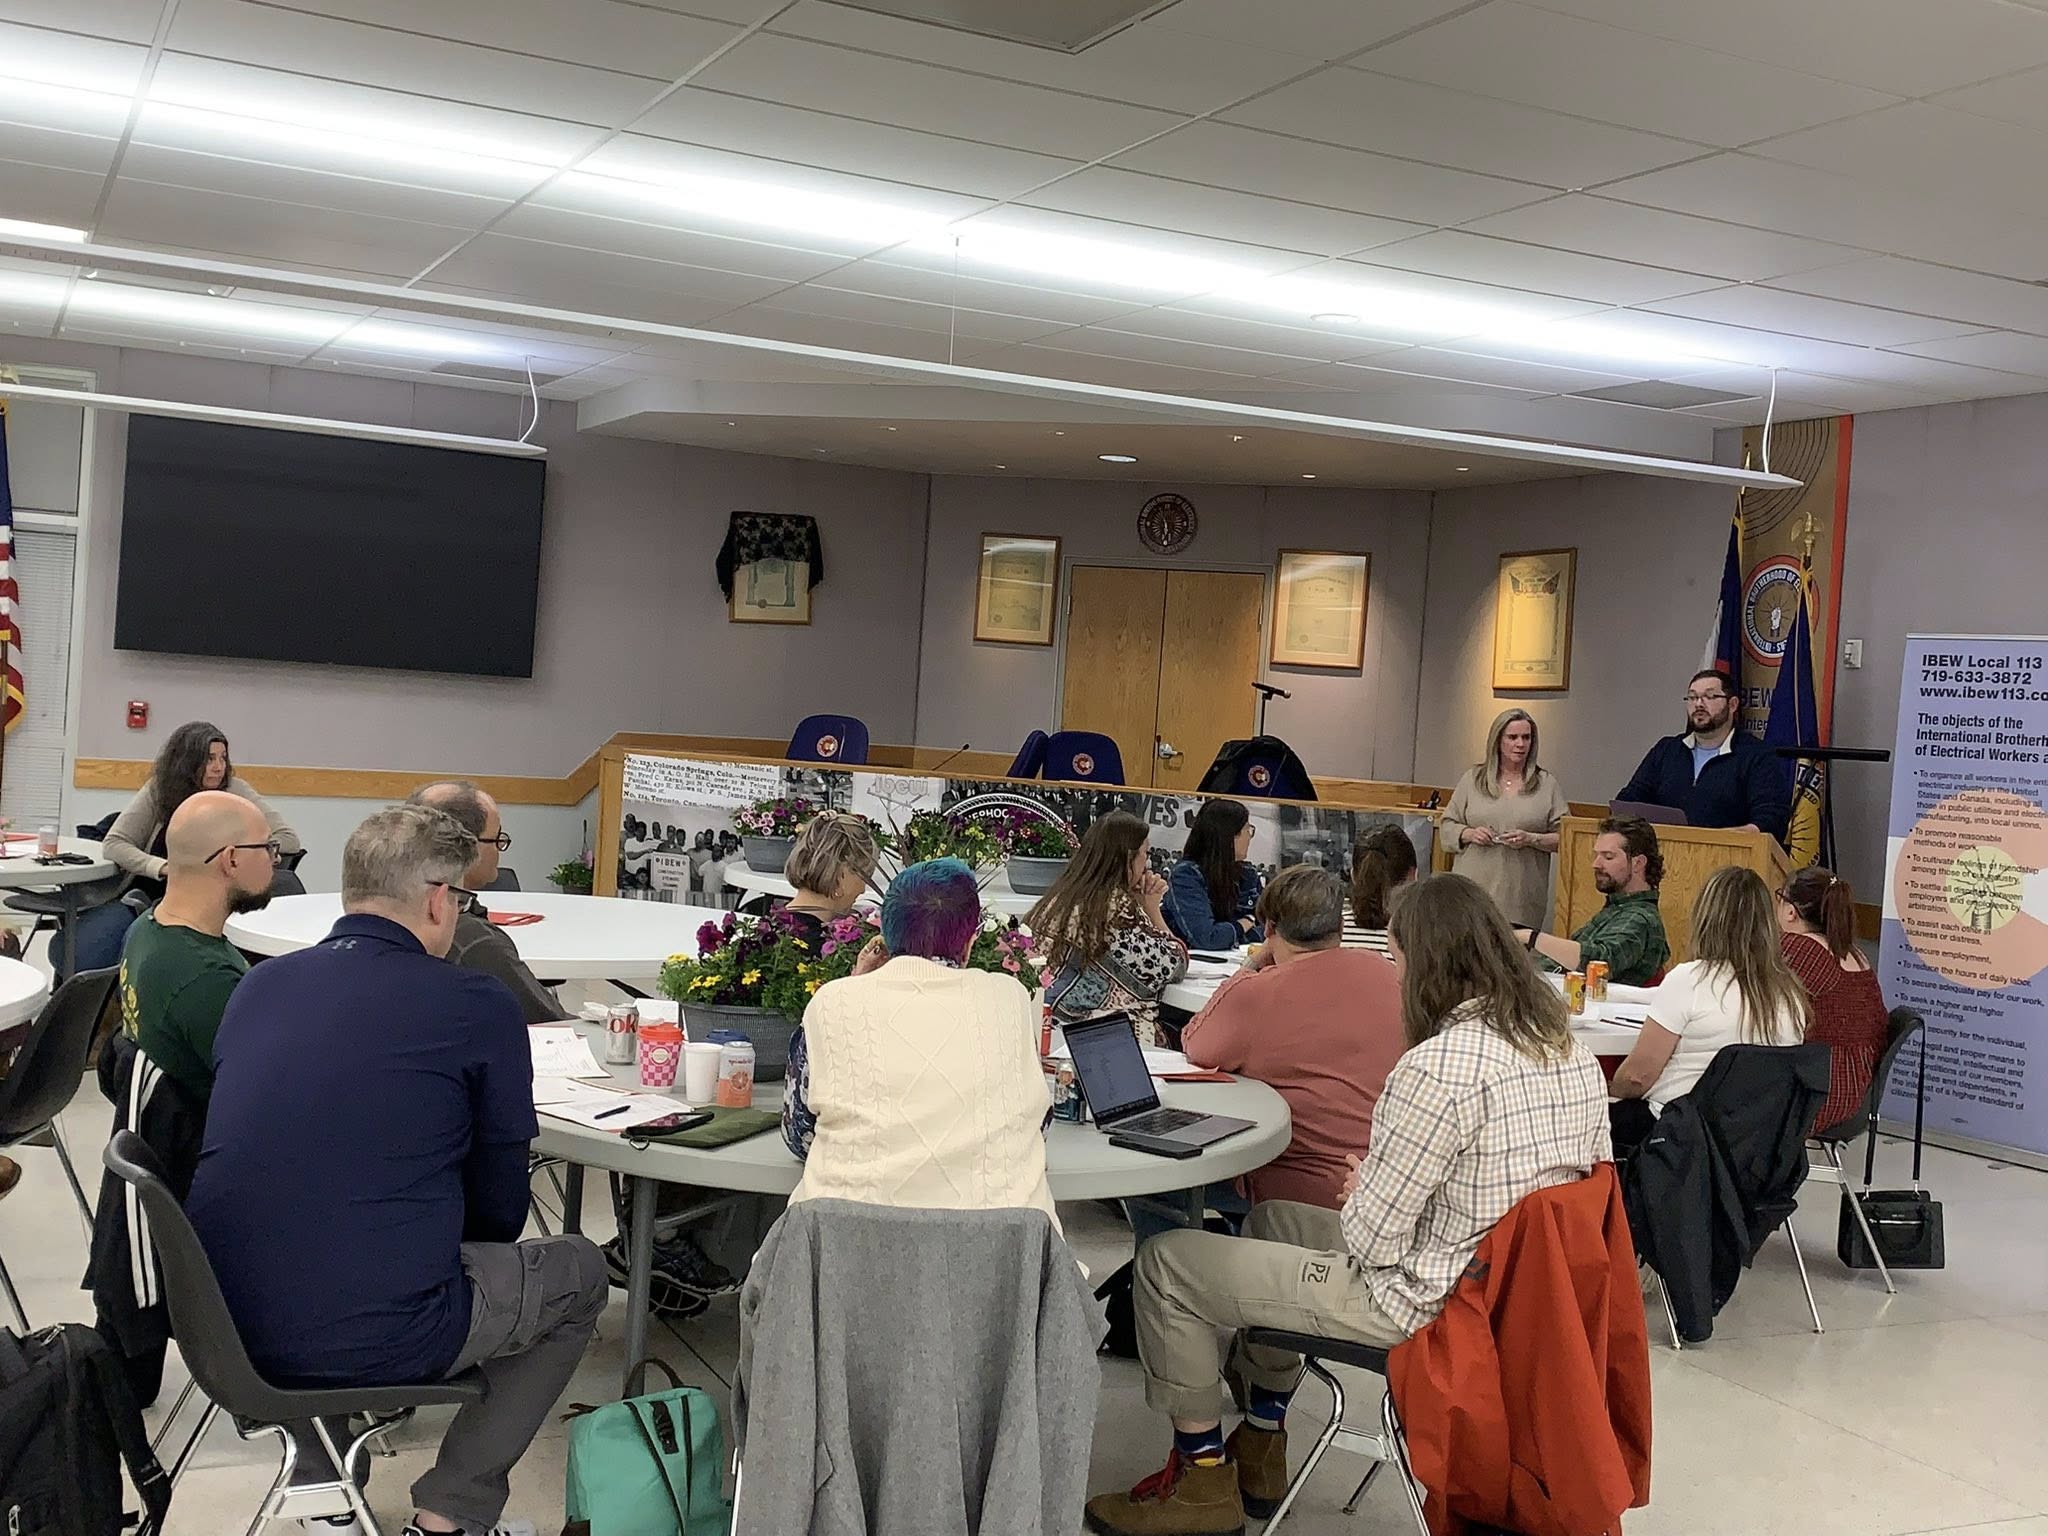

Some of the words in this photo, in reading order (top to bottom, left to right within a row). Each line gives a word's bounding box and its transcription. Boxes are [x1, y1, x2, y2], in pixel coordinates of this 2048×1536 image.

[1922, 654, 1963, 667] IBEW
[1968, 655, 2010, 669] Local
[2016, 657, 2042, 669] 113
[1921, 670, 2032, 685] 719-633-3872
[1918, 712, 1939, 725] The
[1942, 715, 1985, 729] objects
[1988, 716, 2001, 728] of
[2004, 717, 2023, 729] the
[1916, 728, 1992, 744] International
[1915, 744, 1928, 756] of
[1930, 745, 1985, 760] Electrical
[1989, 748, 2040, 763] Workers
[654, 761, 686, 772] Colorado
[1919, 770, 1928, 778] To
[1976, 775, 2007, 783] workers
[1917, 790, 1941, 800] States
[1942, 793, 1958, 801] and
[2011, 787, 2039, 797] United
[1916, 801, 1937, 809] those
[2004, 809, 2019, 817] and
[1991, 818, 2010, 827] local
[1915, 827, 1924, 836] To
[1925, 830, 1957, 840] promote
[1913, 839, 1946, 848] methods
[1948, 841, 1957, 849] of
[1912, 853, 1921, 862] To
[1911, 864, 1937, 875] among
[1909, 880, 1919, 889] To
[1907, 917, 1915, 926] To
[1916, 920, 1940, 929] assist
[1941, 923, 1960, 932] each
[1903, 943, 1913, 952] To
[1914, 946, 1940, 956] secure
[1902, 959, 1911, 968] To
[1912, 962, 1939, 973] reduce
[1941, 966, 1954, 975] the
[1955, 968, 1978, 979] hours
[1979, 972, 1989, 981] of
[1989, 973, 2009, 985] daily
[1901, 976, 1910, 985] To
[1911, 979, 1938, 989] secure
[1993, 991, 2005, 1000] for
[2006, 994, 2021, 1003] our
[1900, 992, 1909, 1001] To
[1936, 1000, 1961, 1010] higher
[1962, 1004, 1978, 1013] and
